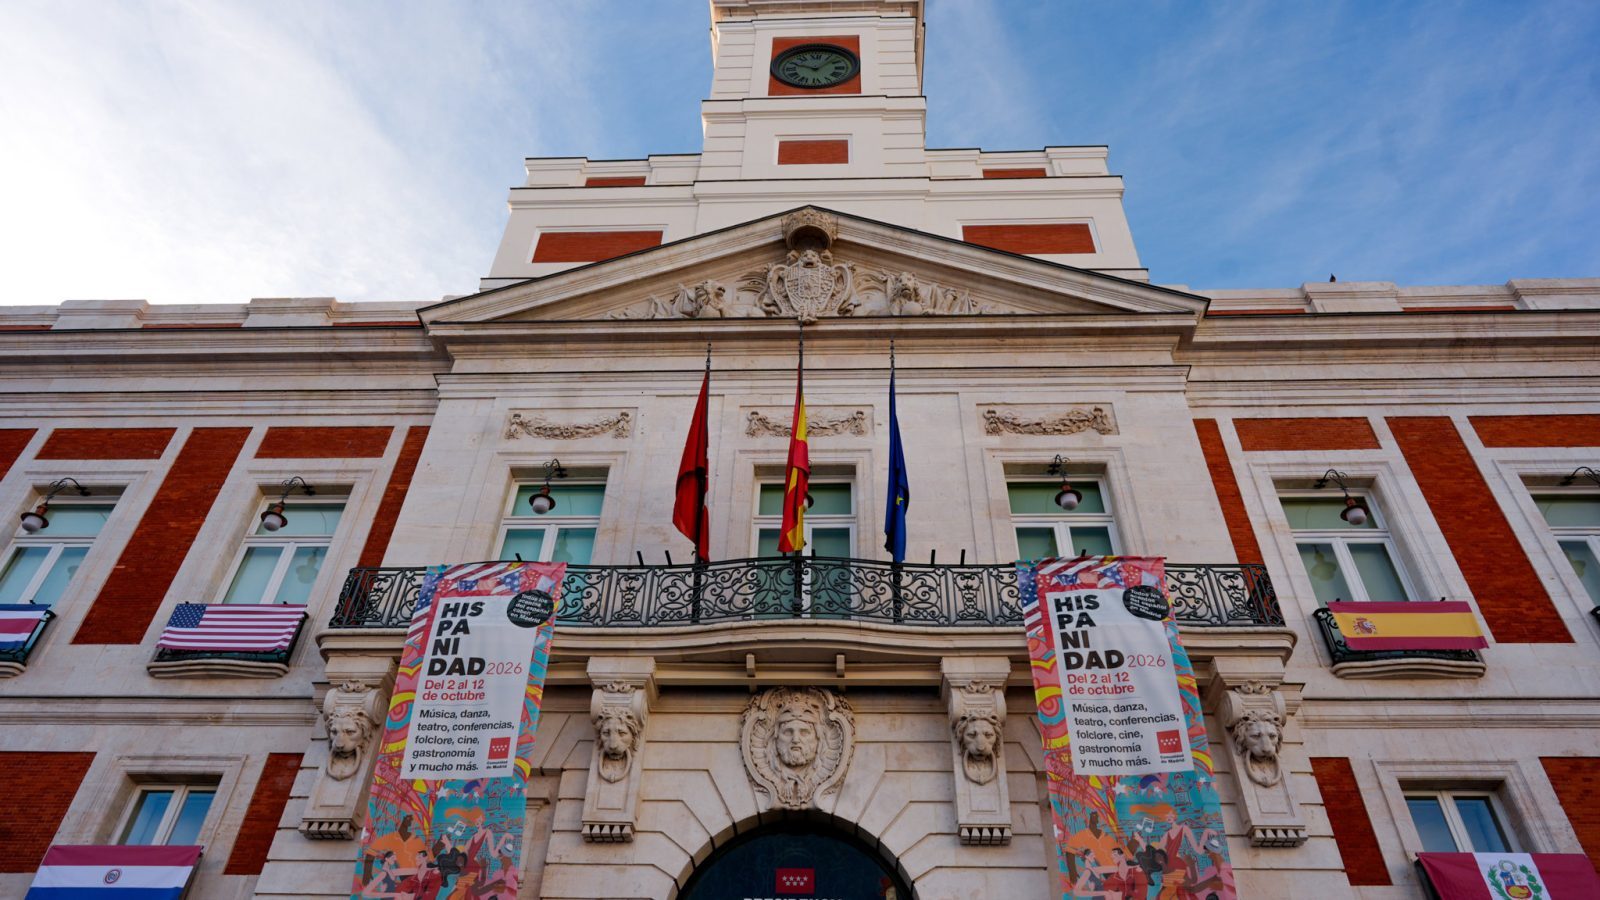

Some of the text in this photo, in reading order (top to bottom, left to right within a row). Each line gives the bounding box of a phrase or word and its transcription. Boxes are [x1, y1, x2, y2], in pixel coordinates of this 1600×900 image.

[1054, 595, 1100, 612] HIS
[441, 602, 484, 618] HIS
[1057, 613, 1096, 629] PA
[436, 619, 470, 636] PA
[1059, 630, 1090, 649] NI
[432, 638, 460, 655] NI
[1064, 650, 1166, 670] DAD 2026
[427, 658, 523, 676] DAD 2026
[1067, 672, 1130, 684] Del 2 al 12
[425, 679, 485, 690] Del 2 al 12
[1069, 684, 1135, 695] de octubre
[423, 691, 485, 701] de octubre
[1072, 703, 1147, 713] Música, danza,
[419, 709, 491, 719] Música, danza,
[1075, 713, 1179, 727] teatro, conferencias,
[417, 721, 514, 732] teatro, conferencias,
[415, 735, 480, 745] folclore, cine,
[1077, 730, 1143, 740] folclore, cine,
[412, 749, 475, 759] gastronomía
[1079, 743, 1141, 754] gastronomía
[410, 762, 479, 772] y mucho más.
[1080, 756, 1151, 768] y mucho más.
